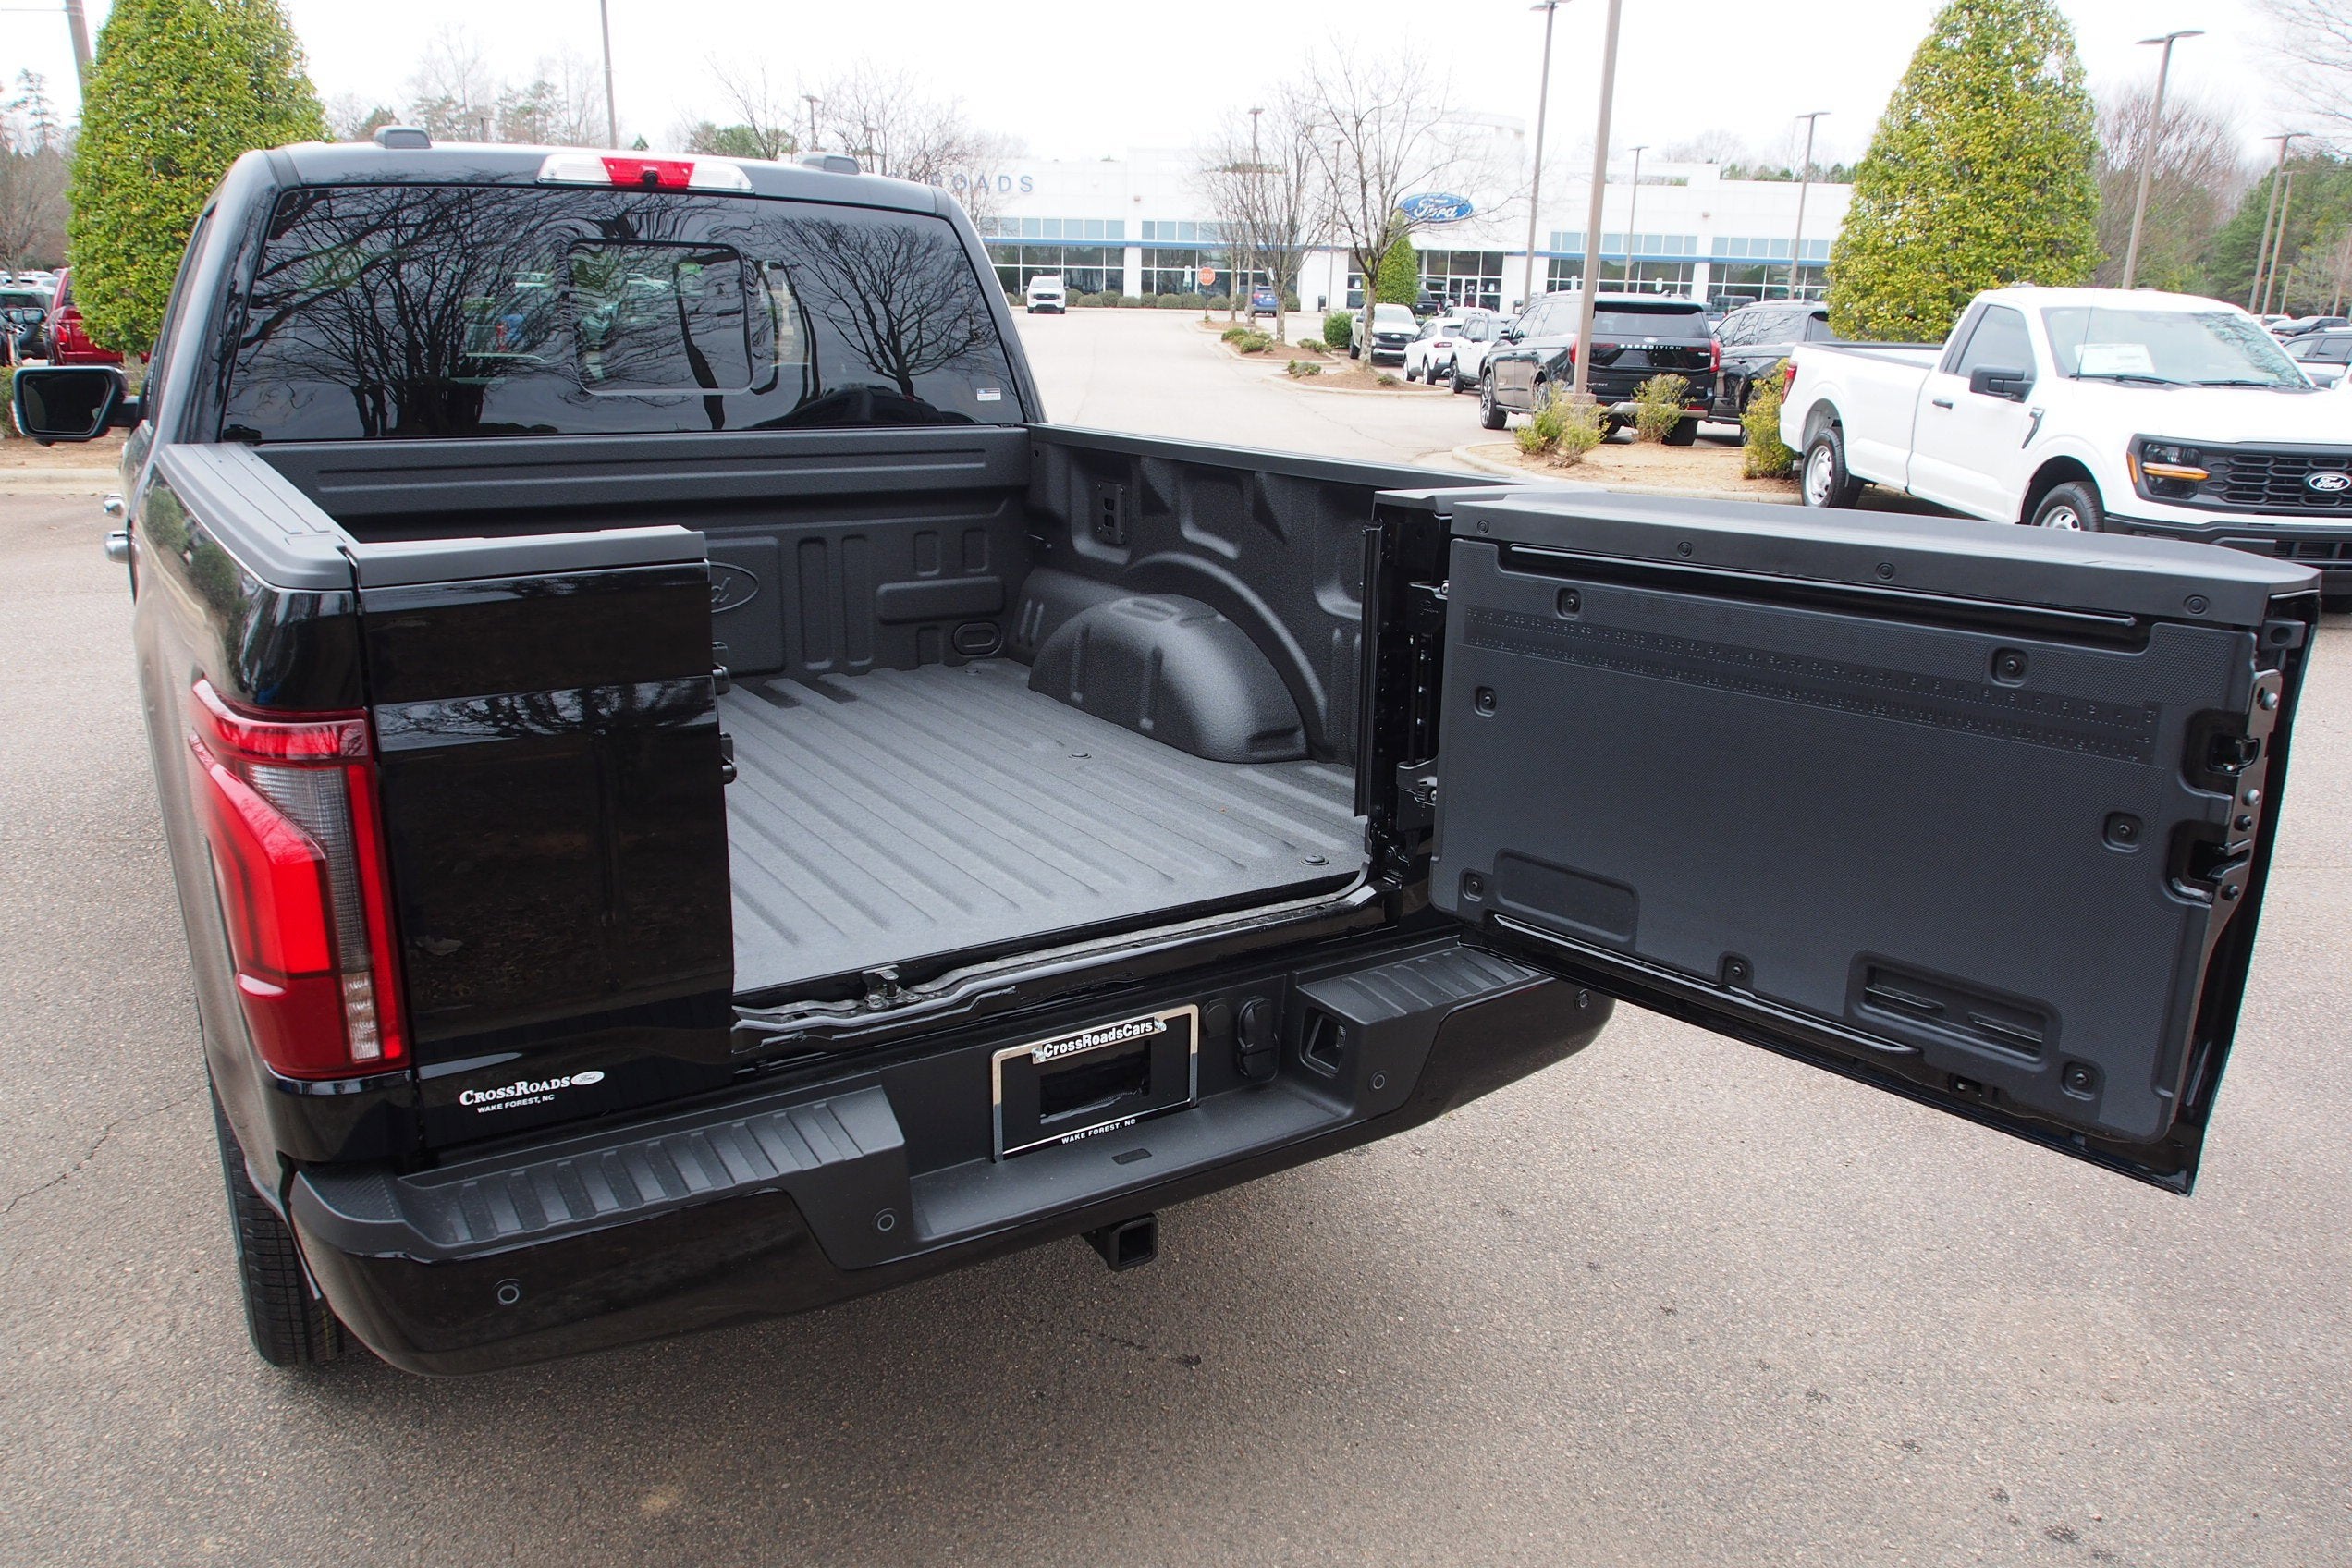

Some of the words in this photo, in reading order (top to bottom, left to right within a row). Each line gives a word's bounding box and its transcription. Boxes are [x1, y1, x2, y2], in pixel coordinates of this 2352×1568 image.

[2316, 476, 2344, 488] Ford
[1043, 1021, 1153, 1058] CrossRoadsCars
[477, 1103, 503, 1114] WAKE
[505, 1096, 541, 1109] FOREST,
[543, 1094, 556, 1102] NC
[1061, 1132, 1086, 1145] WAKE
[1088, 1122, 1122, 1137] FOREST,
